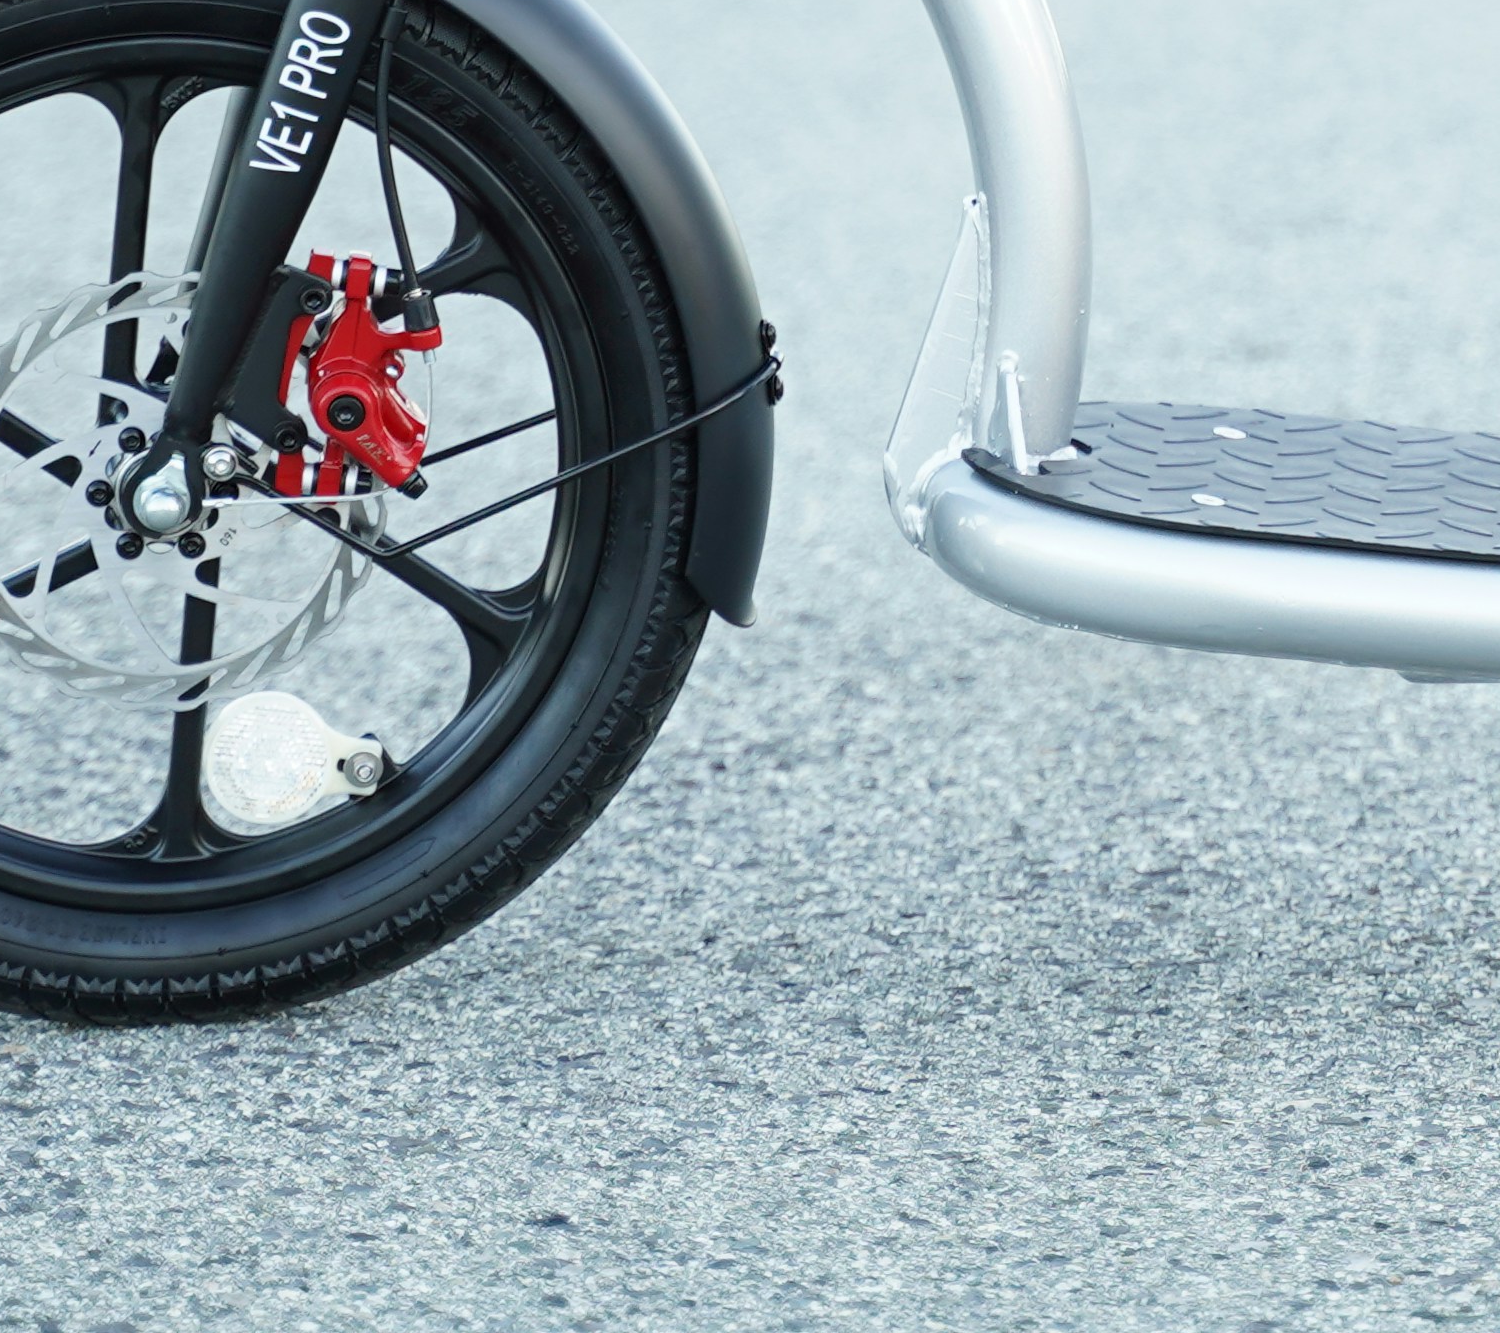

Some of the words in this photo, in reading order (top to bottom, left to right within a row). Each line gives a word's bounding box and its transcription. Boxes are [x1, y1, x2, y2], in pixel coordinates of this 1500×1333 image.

[279, 10, 351, 99] PRO
[249, 101, 319, 172] VE1
[219, 527, 237, 546] 160
